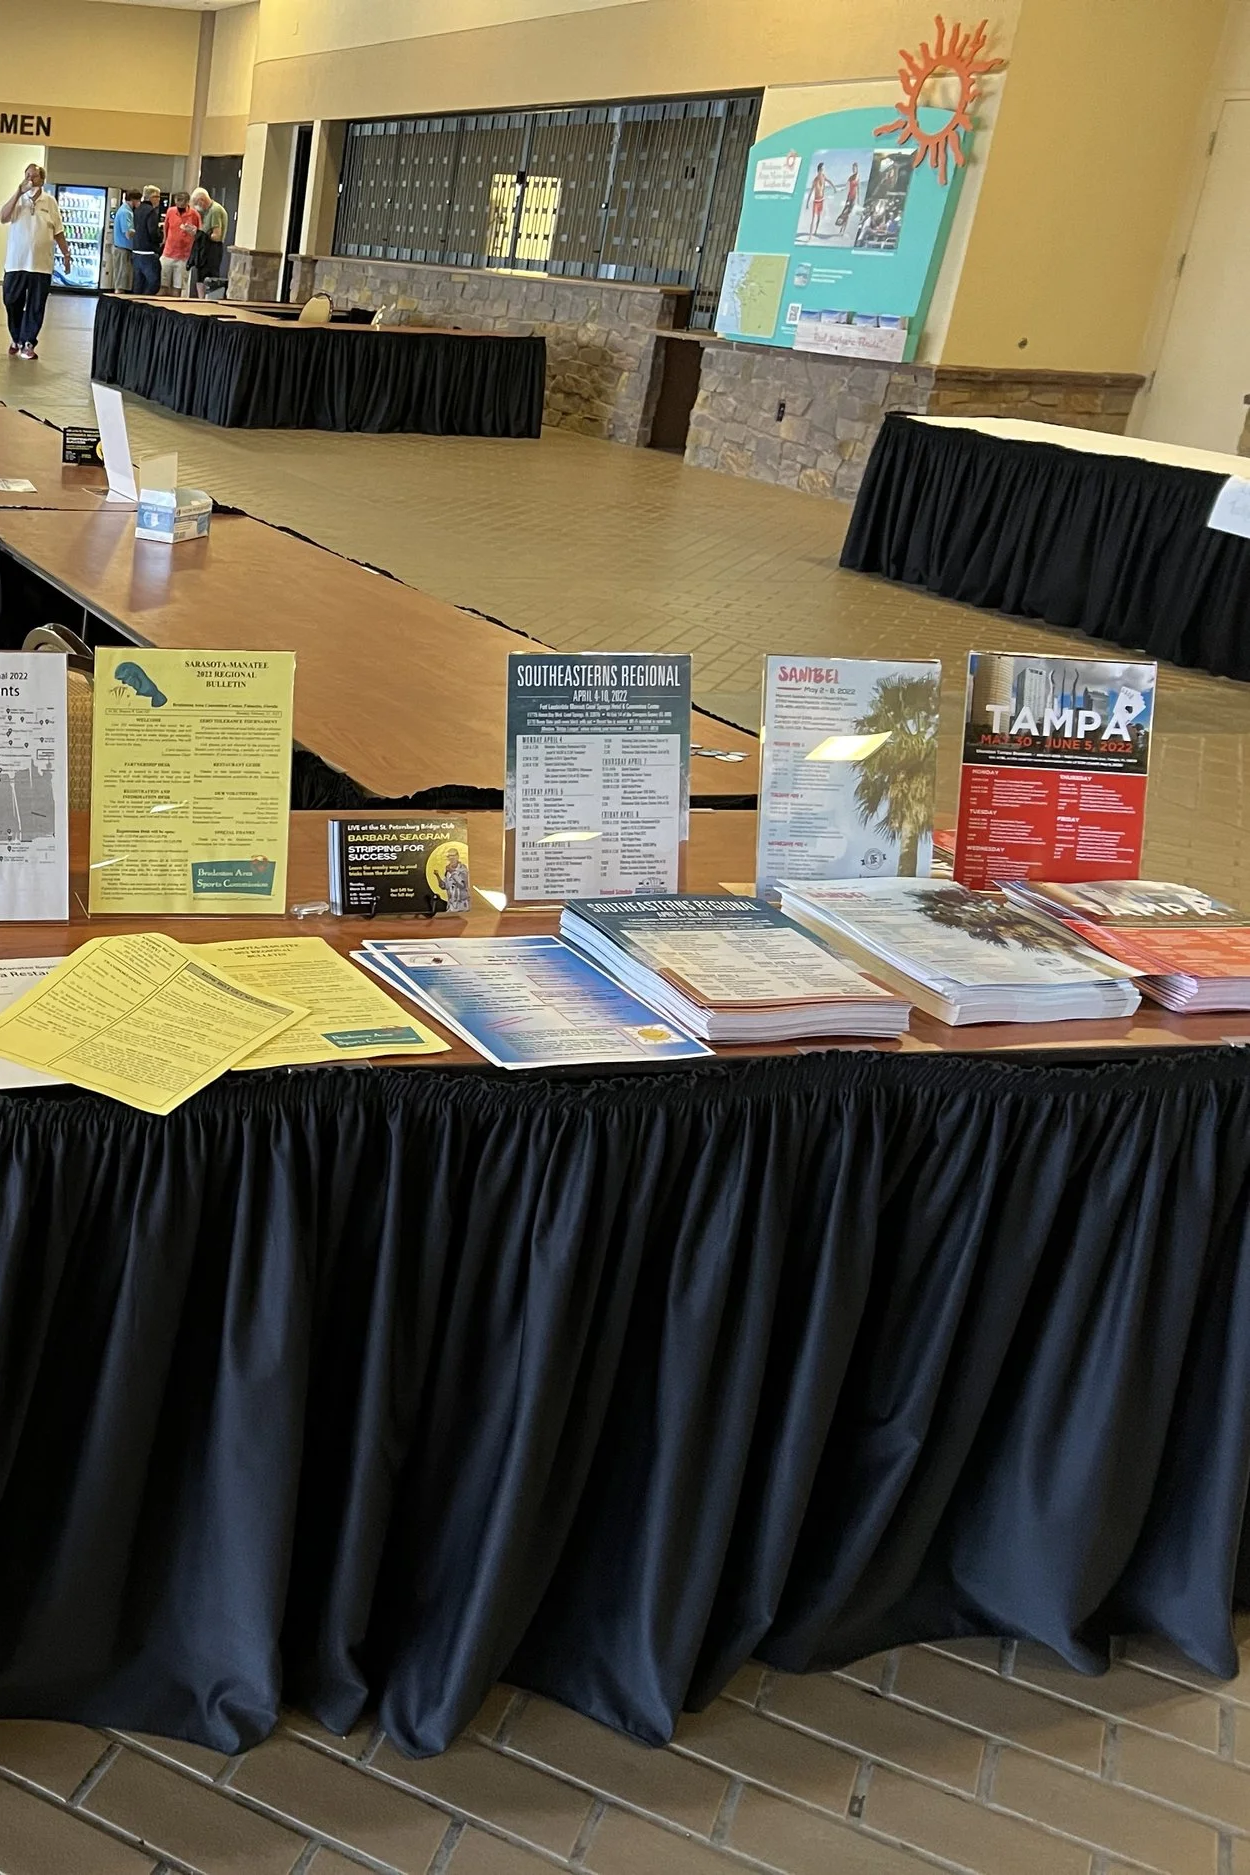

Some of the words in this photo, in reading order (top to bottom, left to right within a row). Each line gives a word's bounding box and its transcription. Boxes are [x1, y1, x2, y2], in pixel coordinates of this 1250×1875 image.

[185, 661, 269, 670] SARASOTA-MANATEE
[9, 672, 28, 680] 2022
[214, 671, 257, 679] REGIONAL
[517, 665, 618, 687] SOUTHEASTERNS
[621, 664, 681, 687] REGIONAL
[803, 686, 819, 695] May
[572, 690, 593, 702] APRIL
[610, 690, 628, 702] 2022
[985, 704, 1131, 741] TAMPA
[981, 734, 1009, 744] MAY
[1016, 736, 1032, 747] 30
[1045, 738, 1080, 750] JUNE
[1084, 740, 1095, 751] 5,
[1100, 742, 1133, 753] 2022
[348, 834, 398, 842] BARBARA
[348, 845, 402, 853] STRIPPING
[348, 853, 398, 861] SUCCESS
[197, 879, 222, 889] Sports
[586, 900, 696, 913] SOUTHEASTERNS
[695, 900, 762, 911] REGIONAL
